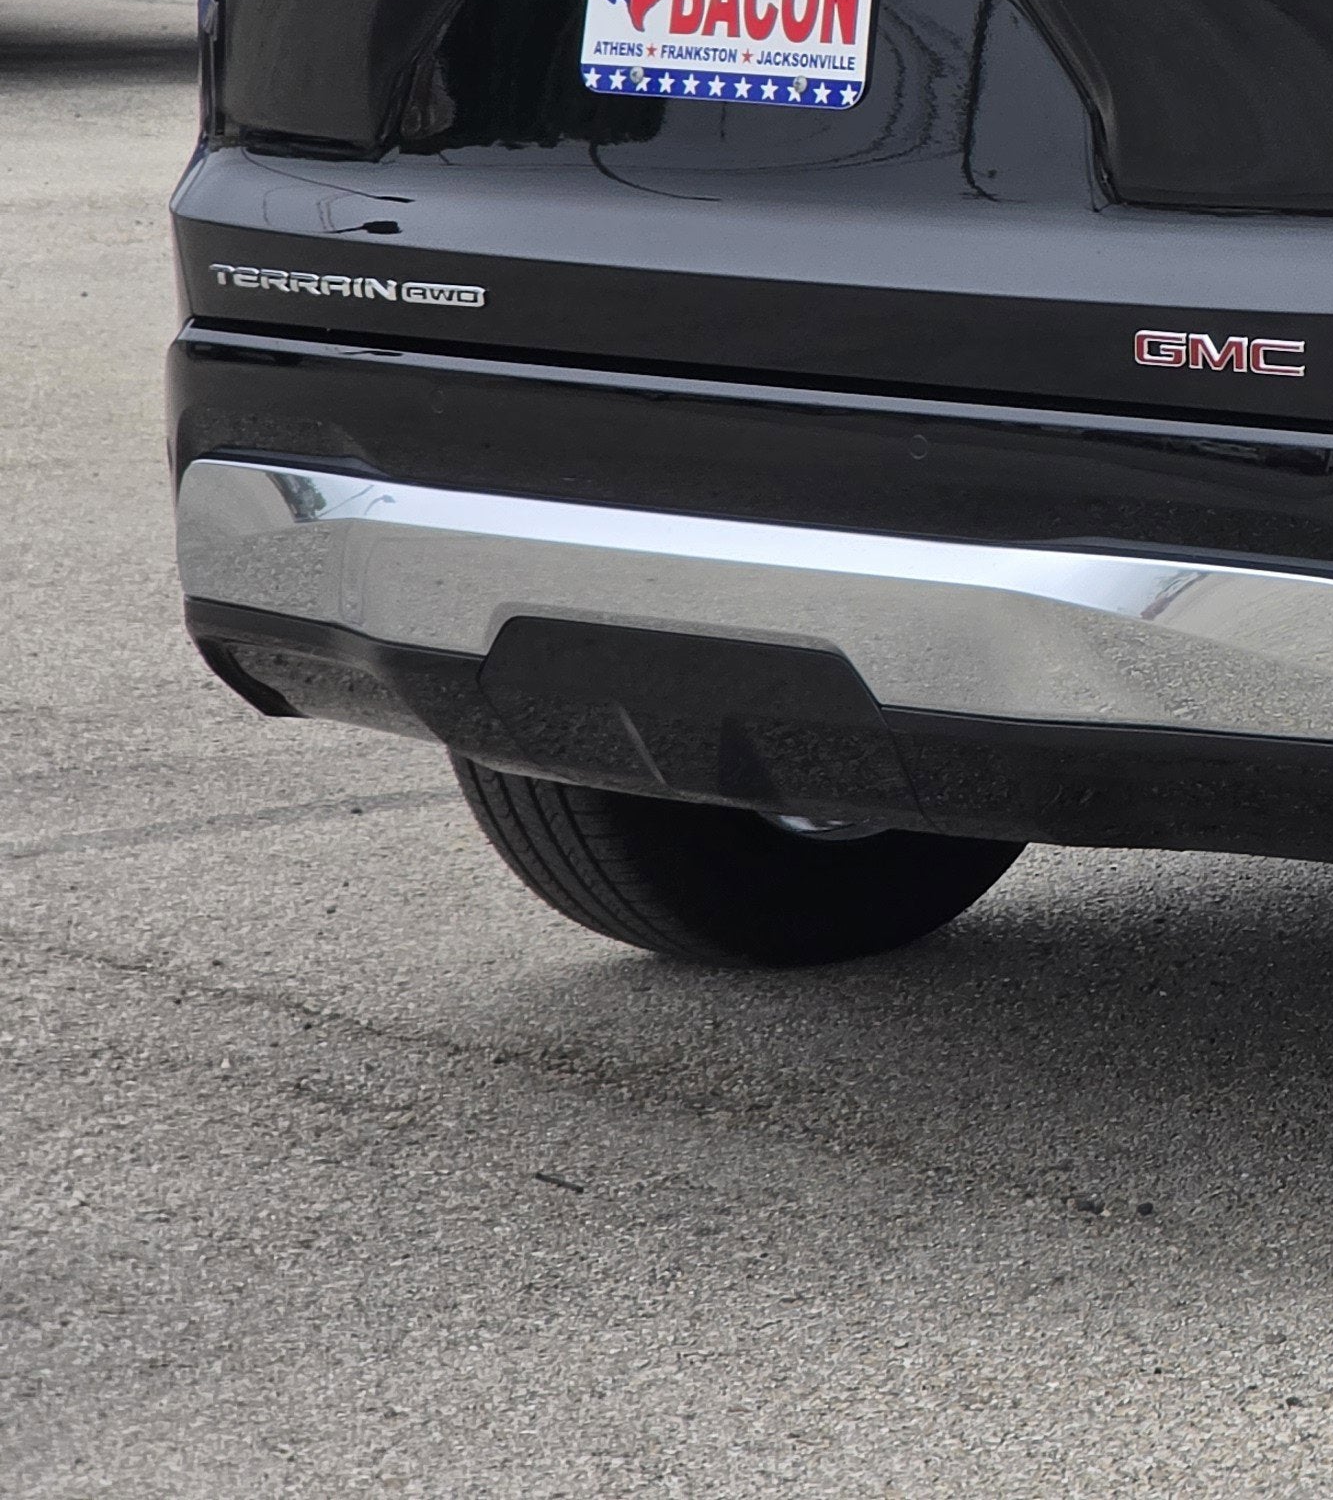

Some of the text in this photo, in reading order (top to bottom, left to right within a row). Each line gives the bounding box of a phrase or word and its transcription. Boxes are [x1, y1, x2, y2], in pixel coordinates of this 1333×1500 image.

[593, 41, 856, 71] ATHENS FRANKSTON JACKSONVILLE
[209, 263, 483, 306] TERRAIN AWD
[1134, 329, 1306, 377] GMC
